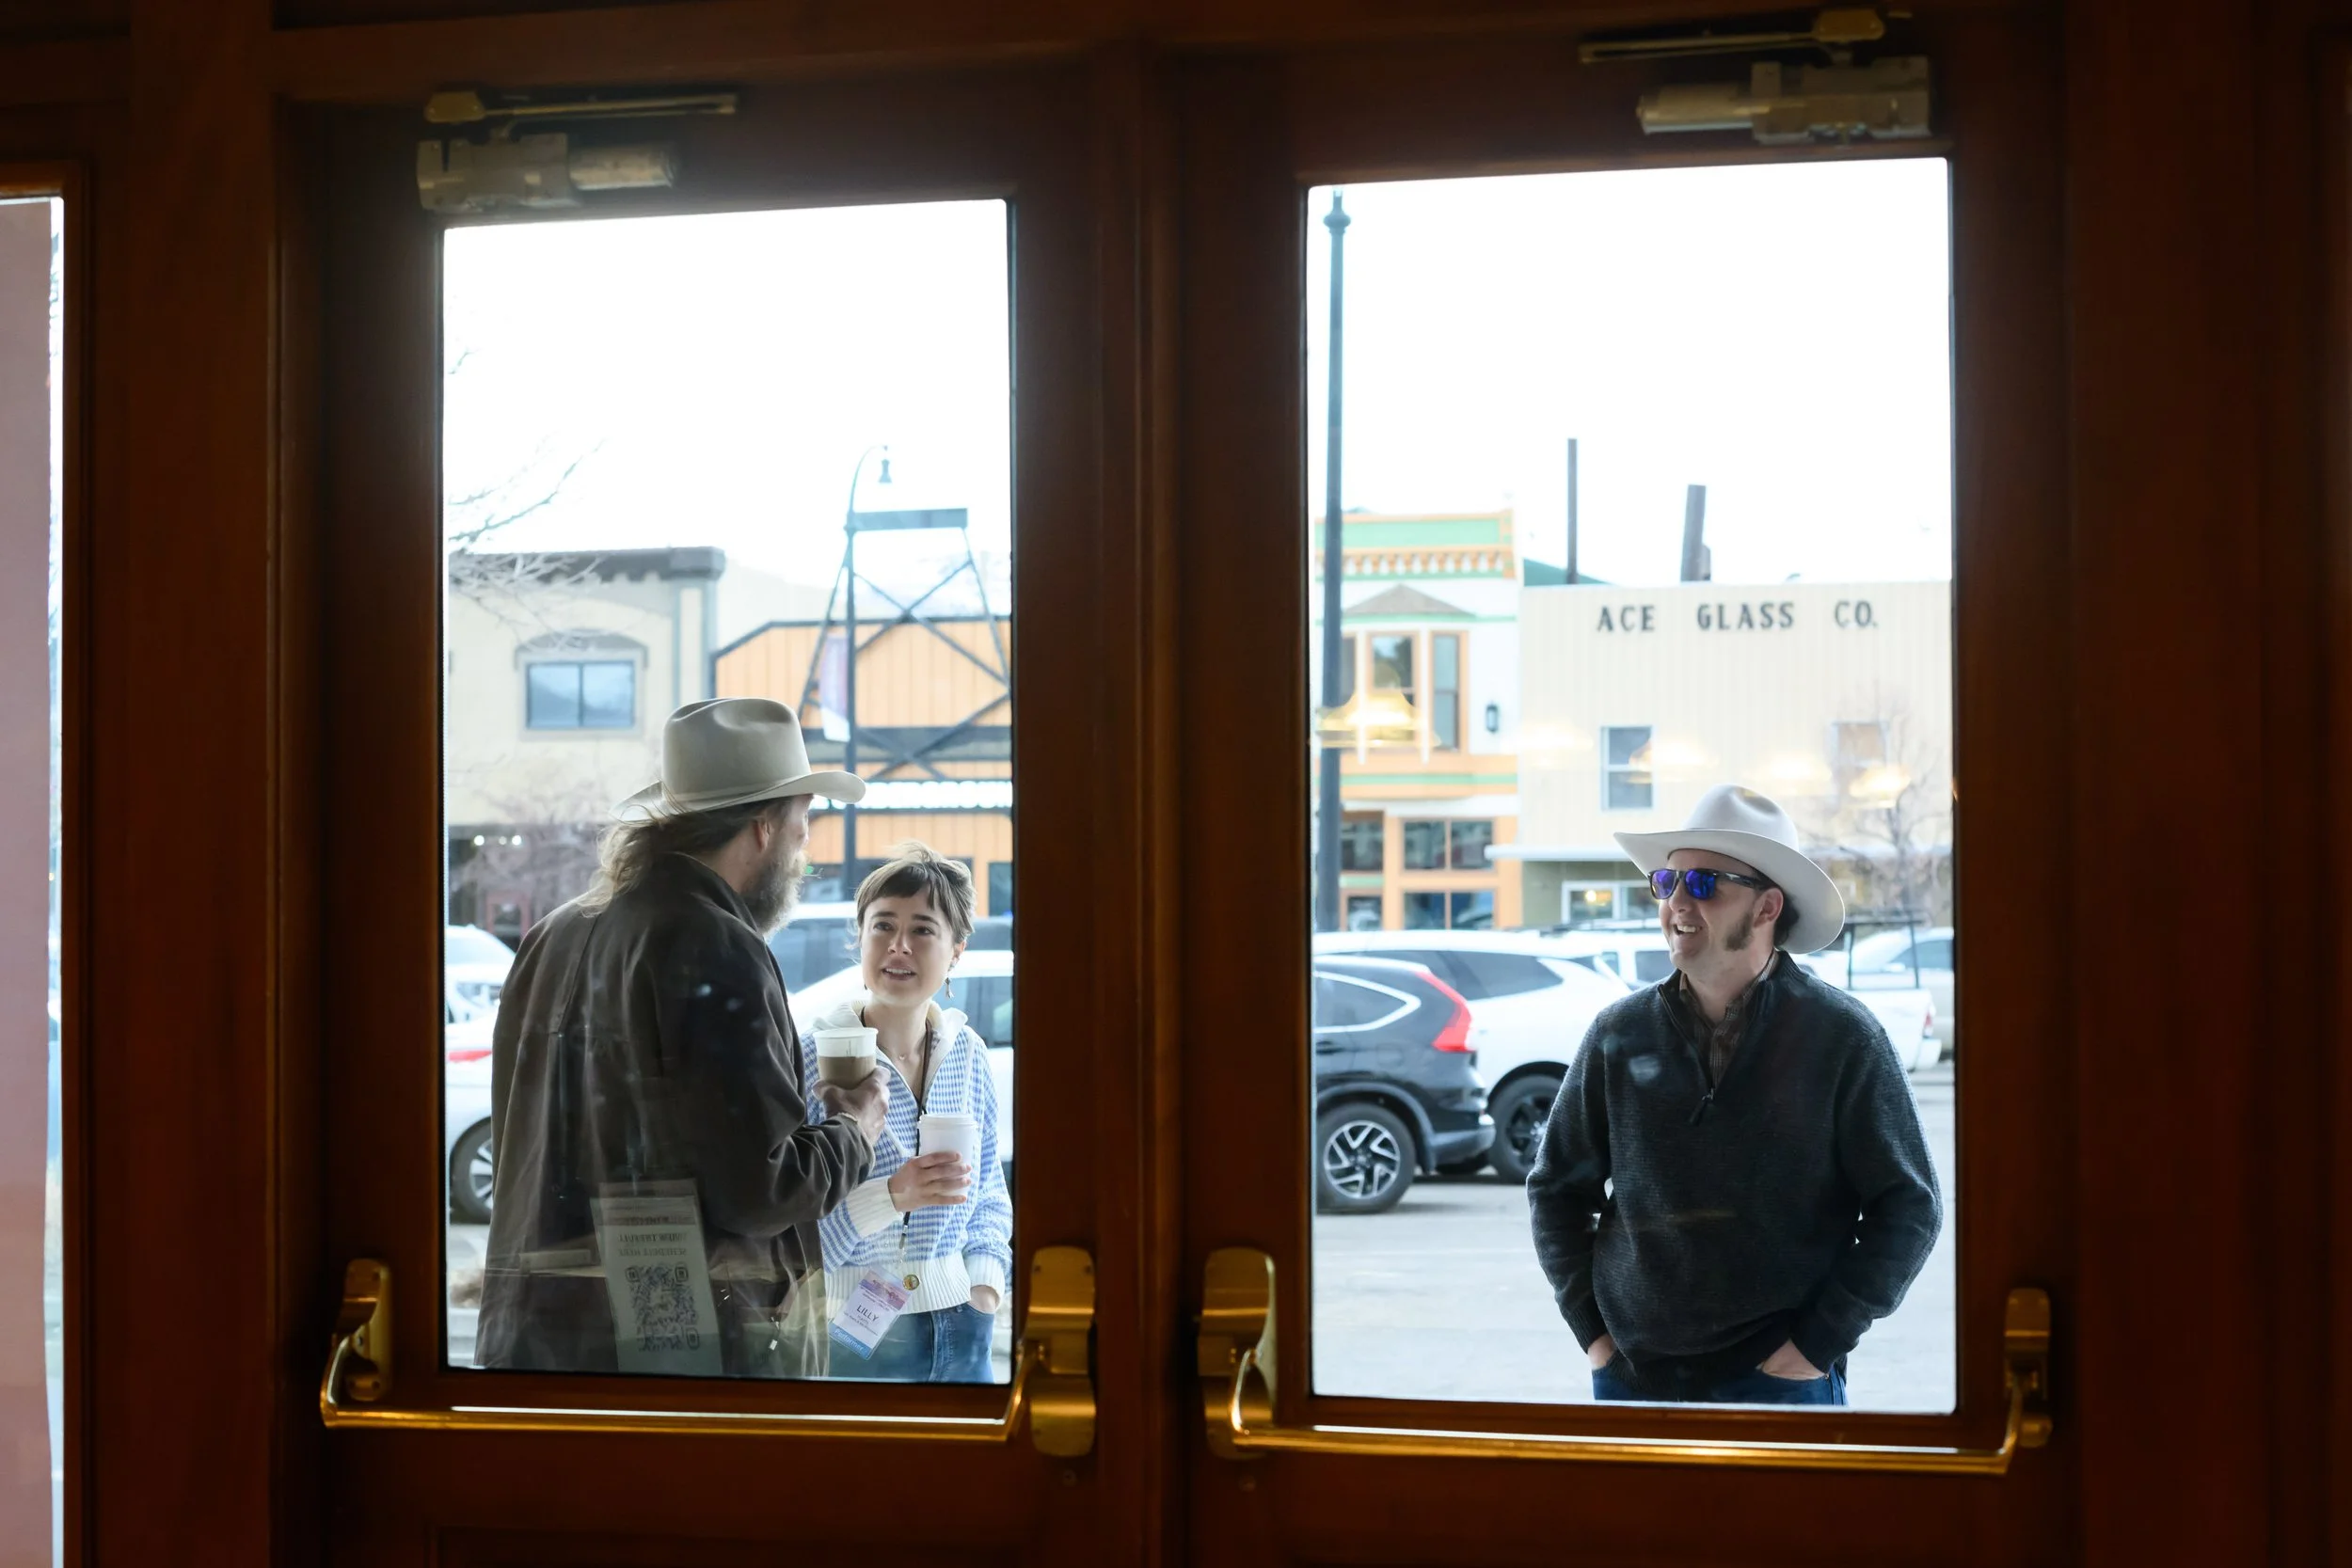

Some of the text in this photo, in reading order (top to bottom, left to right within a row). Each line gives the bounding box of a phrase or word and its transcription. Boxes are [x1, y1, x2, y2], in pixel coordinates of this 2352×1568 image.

[1597, 600, 1878, 632] ACE GLASS CO.
[856, 1304, 879, 1322] LILLY
[834, 1328, 864, 1351] Performer
